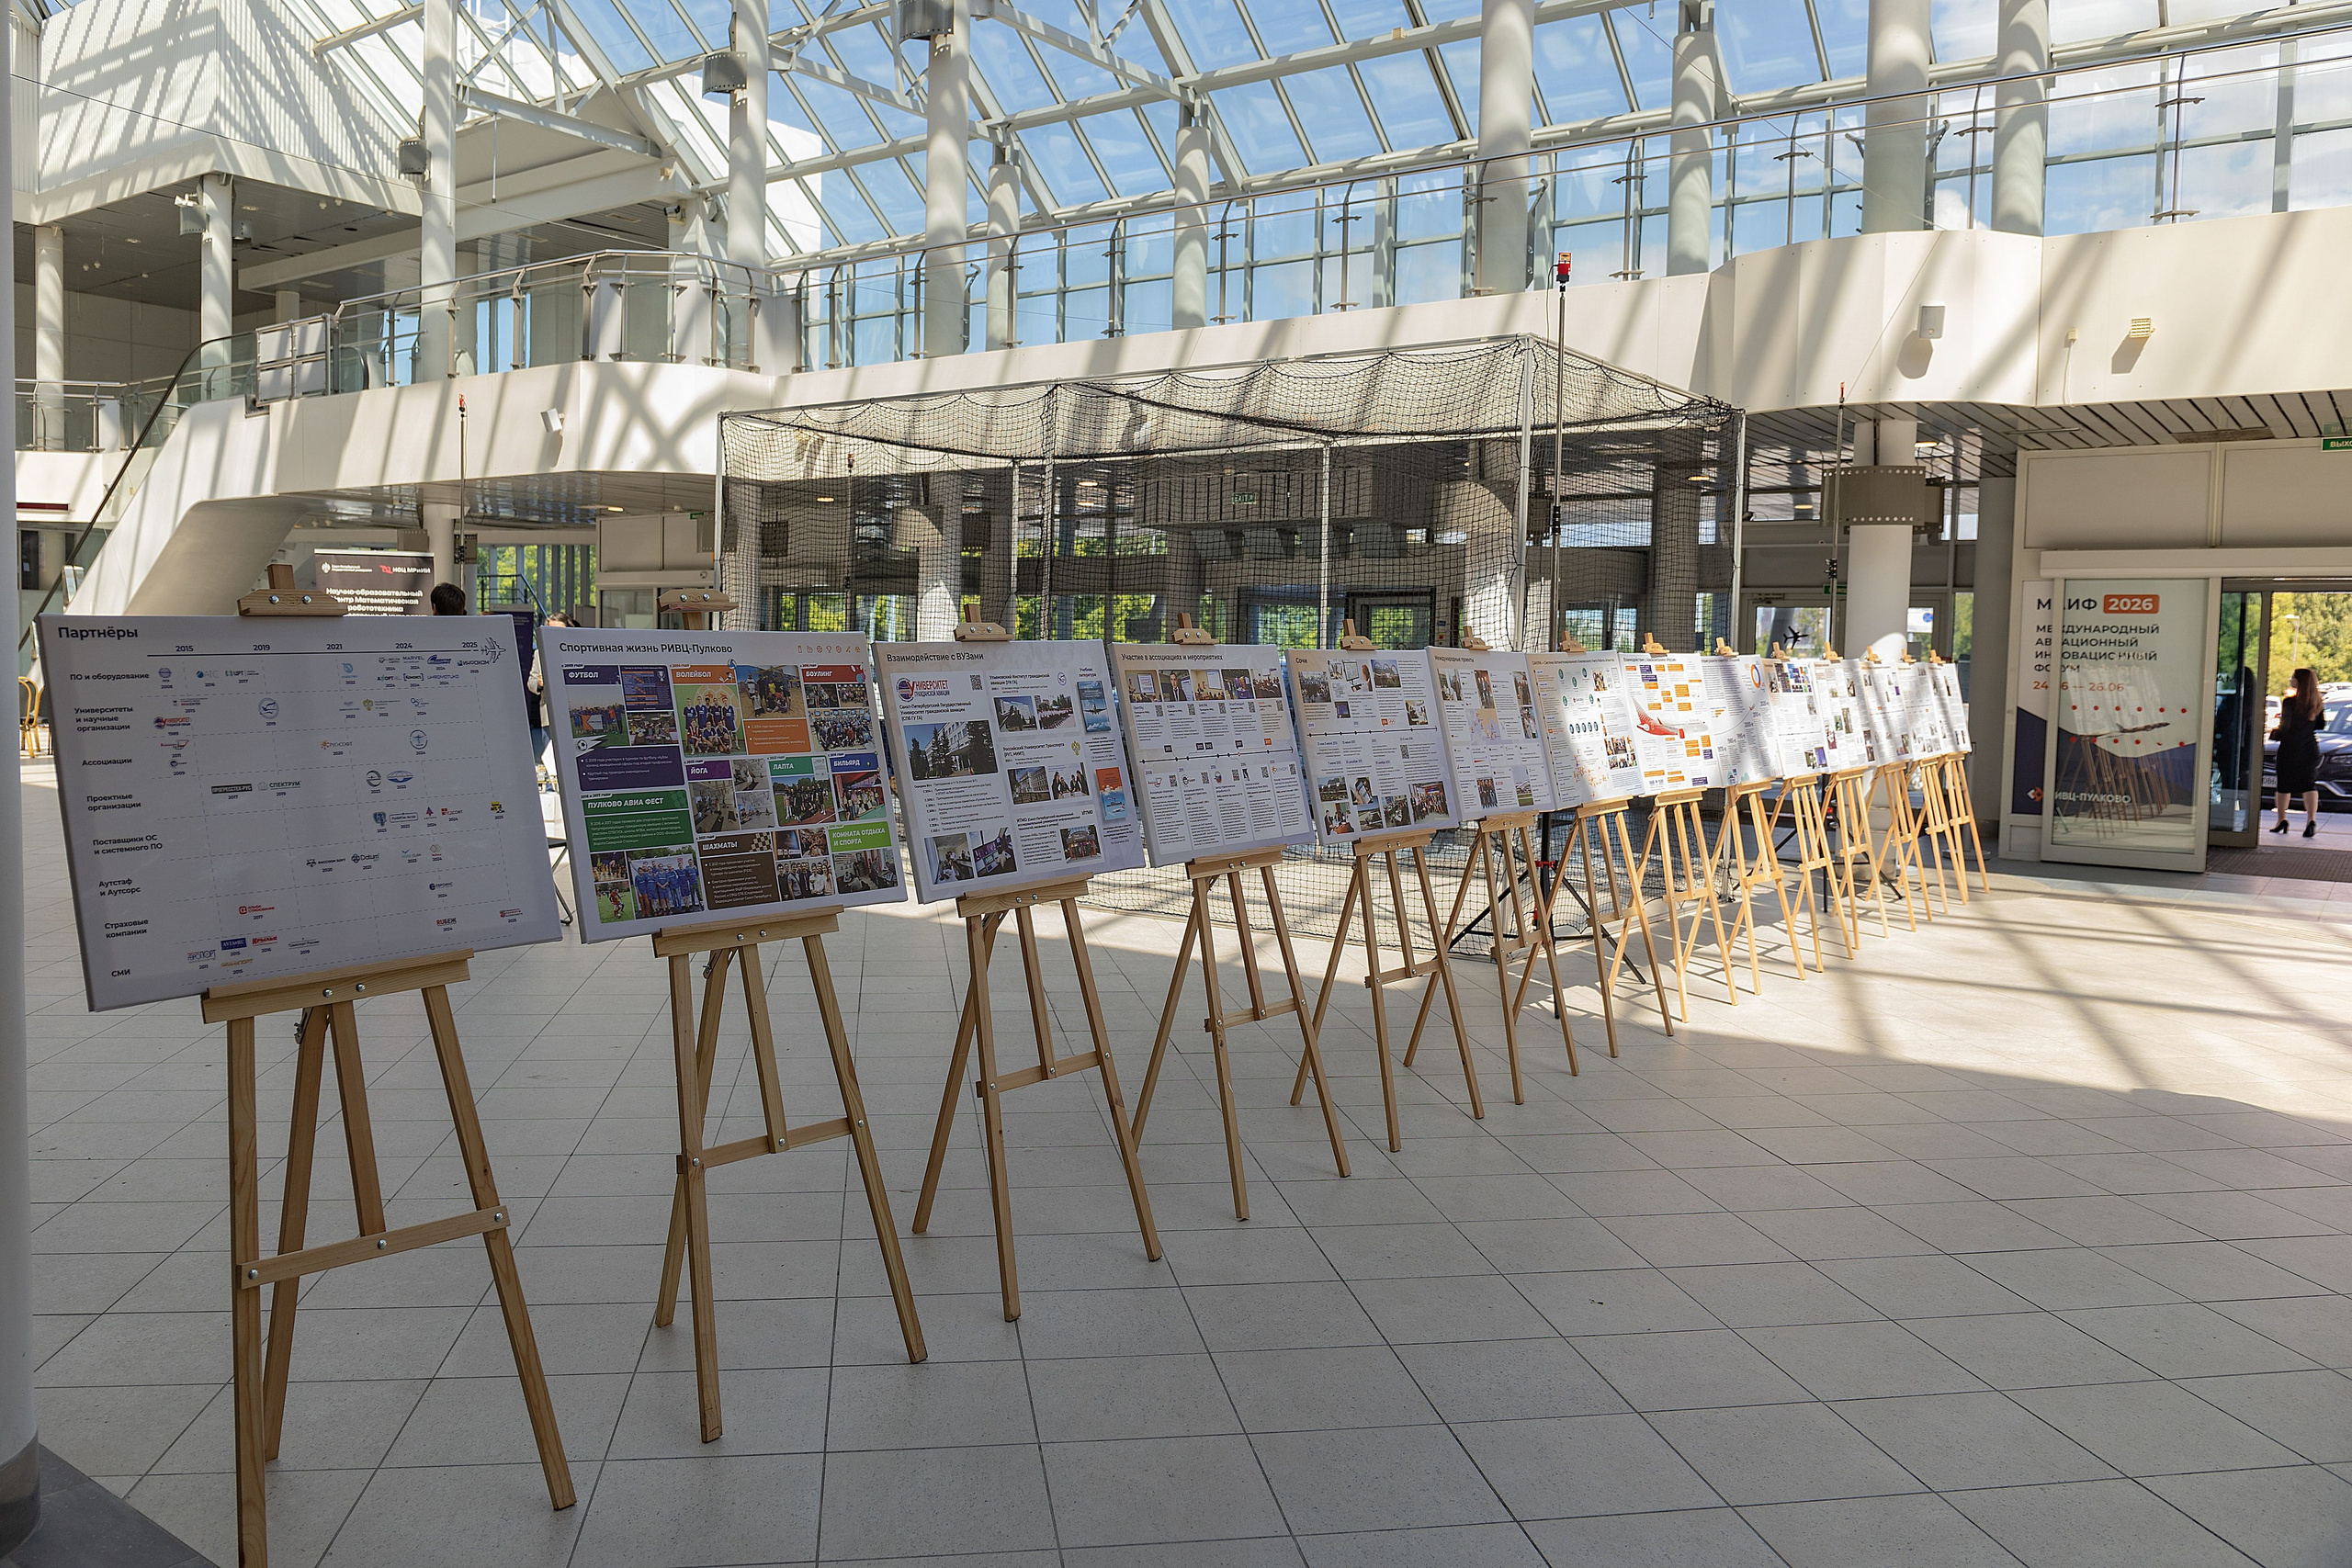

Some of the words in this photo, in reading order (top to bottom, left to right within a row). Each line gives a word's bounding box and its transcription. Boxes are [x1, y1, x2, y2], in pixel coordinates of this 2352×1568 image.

[326, 588, 424, 597] Научно-образовательный
[2037, 598, 2097, 610] МИФ
[2108, 598, 2154, 611] 2026
[58, 626, 138, 640] Партнёры
[2035, 637, 2139, 648] АВАЦИОННЫЙ
[560, 643, 623, 654] Спортивная
[627, 645, 659, 653] жизнь
[661, 644, 732, 654] РИВЦ-Пулково
[887, 653, 949, 662] Взаимодействие
[956, 652, 984, 660] ВУЗами
[2035, 650, 2157, 661] ИНОВАЦИОННЫЙ
[2034, 663, 2080, 673] ФОУМ
[92, 671, 150, 682] оборудование
[2088, 682, 2124, 692] 26.06
[74, 706, 133, 715] Университеты
[83, 716, 119, 724] научные
[77, 724, 130, 733] организации
[82, 758, 132, 767] Ассоциации
[86, 794, 132, 803] Проектные
[2054, 791, 2132, 804] ИВЦ-ПУЛКОВО
[87, 802, 141, 812] организации
[861, 828, 886, 836] ОТДЫХА
[93, 835, 143, 846] Поставщики
[101, 845, 149, 854] системного
[150, 842, 163, 851] ПО
[703, 841, 737, 851] ШАХМАТЫ
[98, 878, 132, 888] Аутстаф
[107, 886, 141, 897] Аутсорс
[105, 919, 149, 931] Страховые
[106, 929, 147, 939] компании
[111, 969, 130, 977] СМИ
